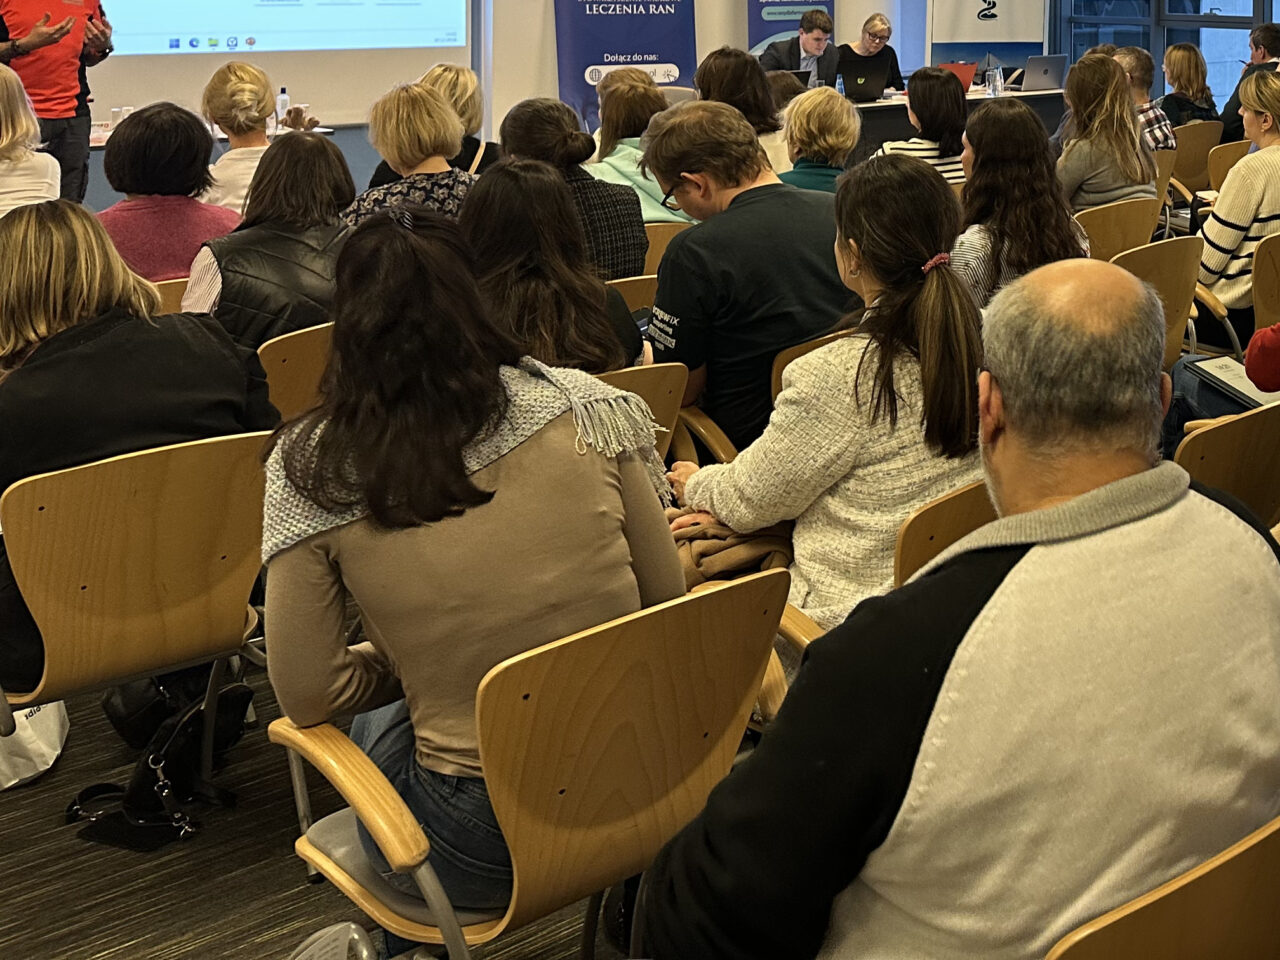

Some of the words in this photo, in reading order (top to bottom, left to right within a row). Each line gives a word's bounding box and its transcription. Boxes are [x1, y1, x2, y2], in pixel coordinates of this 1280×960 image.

[585, 3, 646, 14] LECZENIA
[649, 3, 675, 14] RAN
[603, 53, 631, 63] Dołącz
[632, 52, 643, 61] do
[643, 53, 659, 61] nas:
